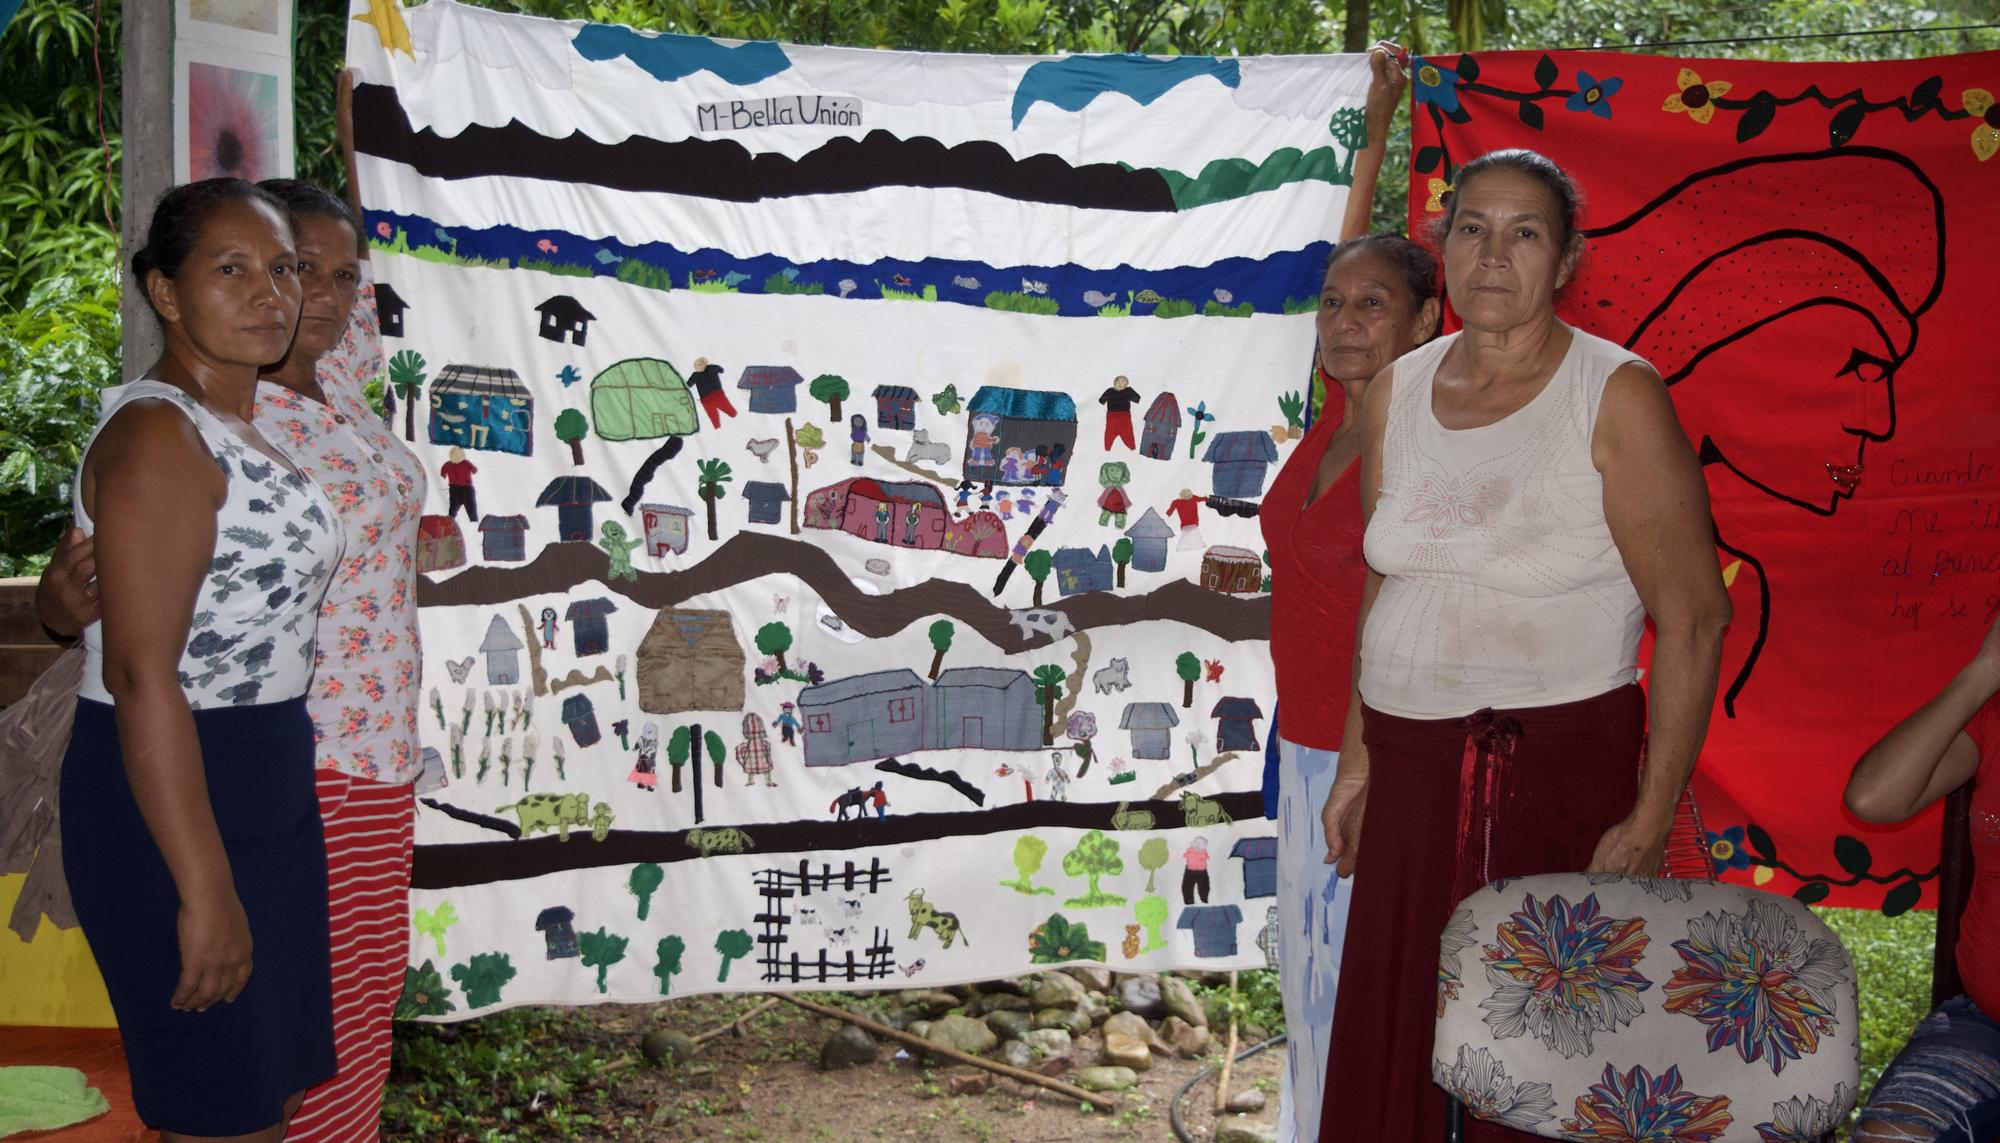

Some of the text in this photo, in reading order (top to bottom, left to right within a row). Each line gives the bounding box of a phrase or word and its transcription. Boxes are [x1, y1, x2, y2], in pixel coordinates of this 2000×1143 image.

[698, 96, 861, 131] M-Bella Unión
[1928, 549, 2000, 587] princ
